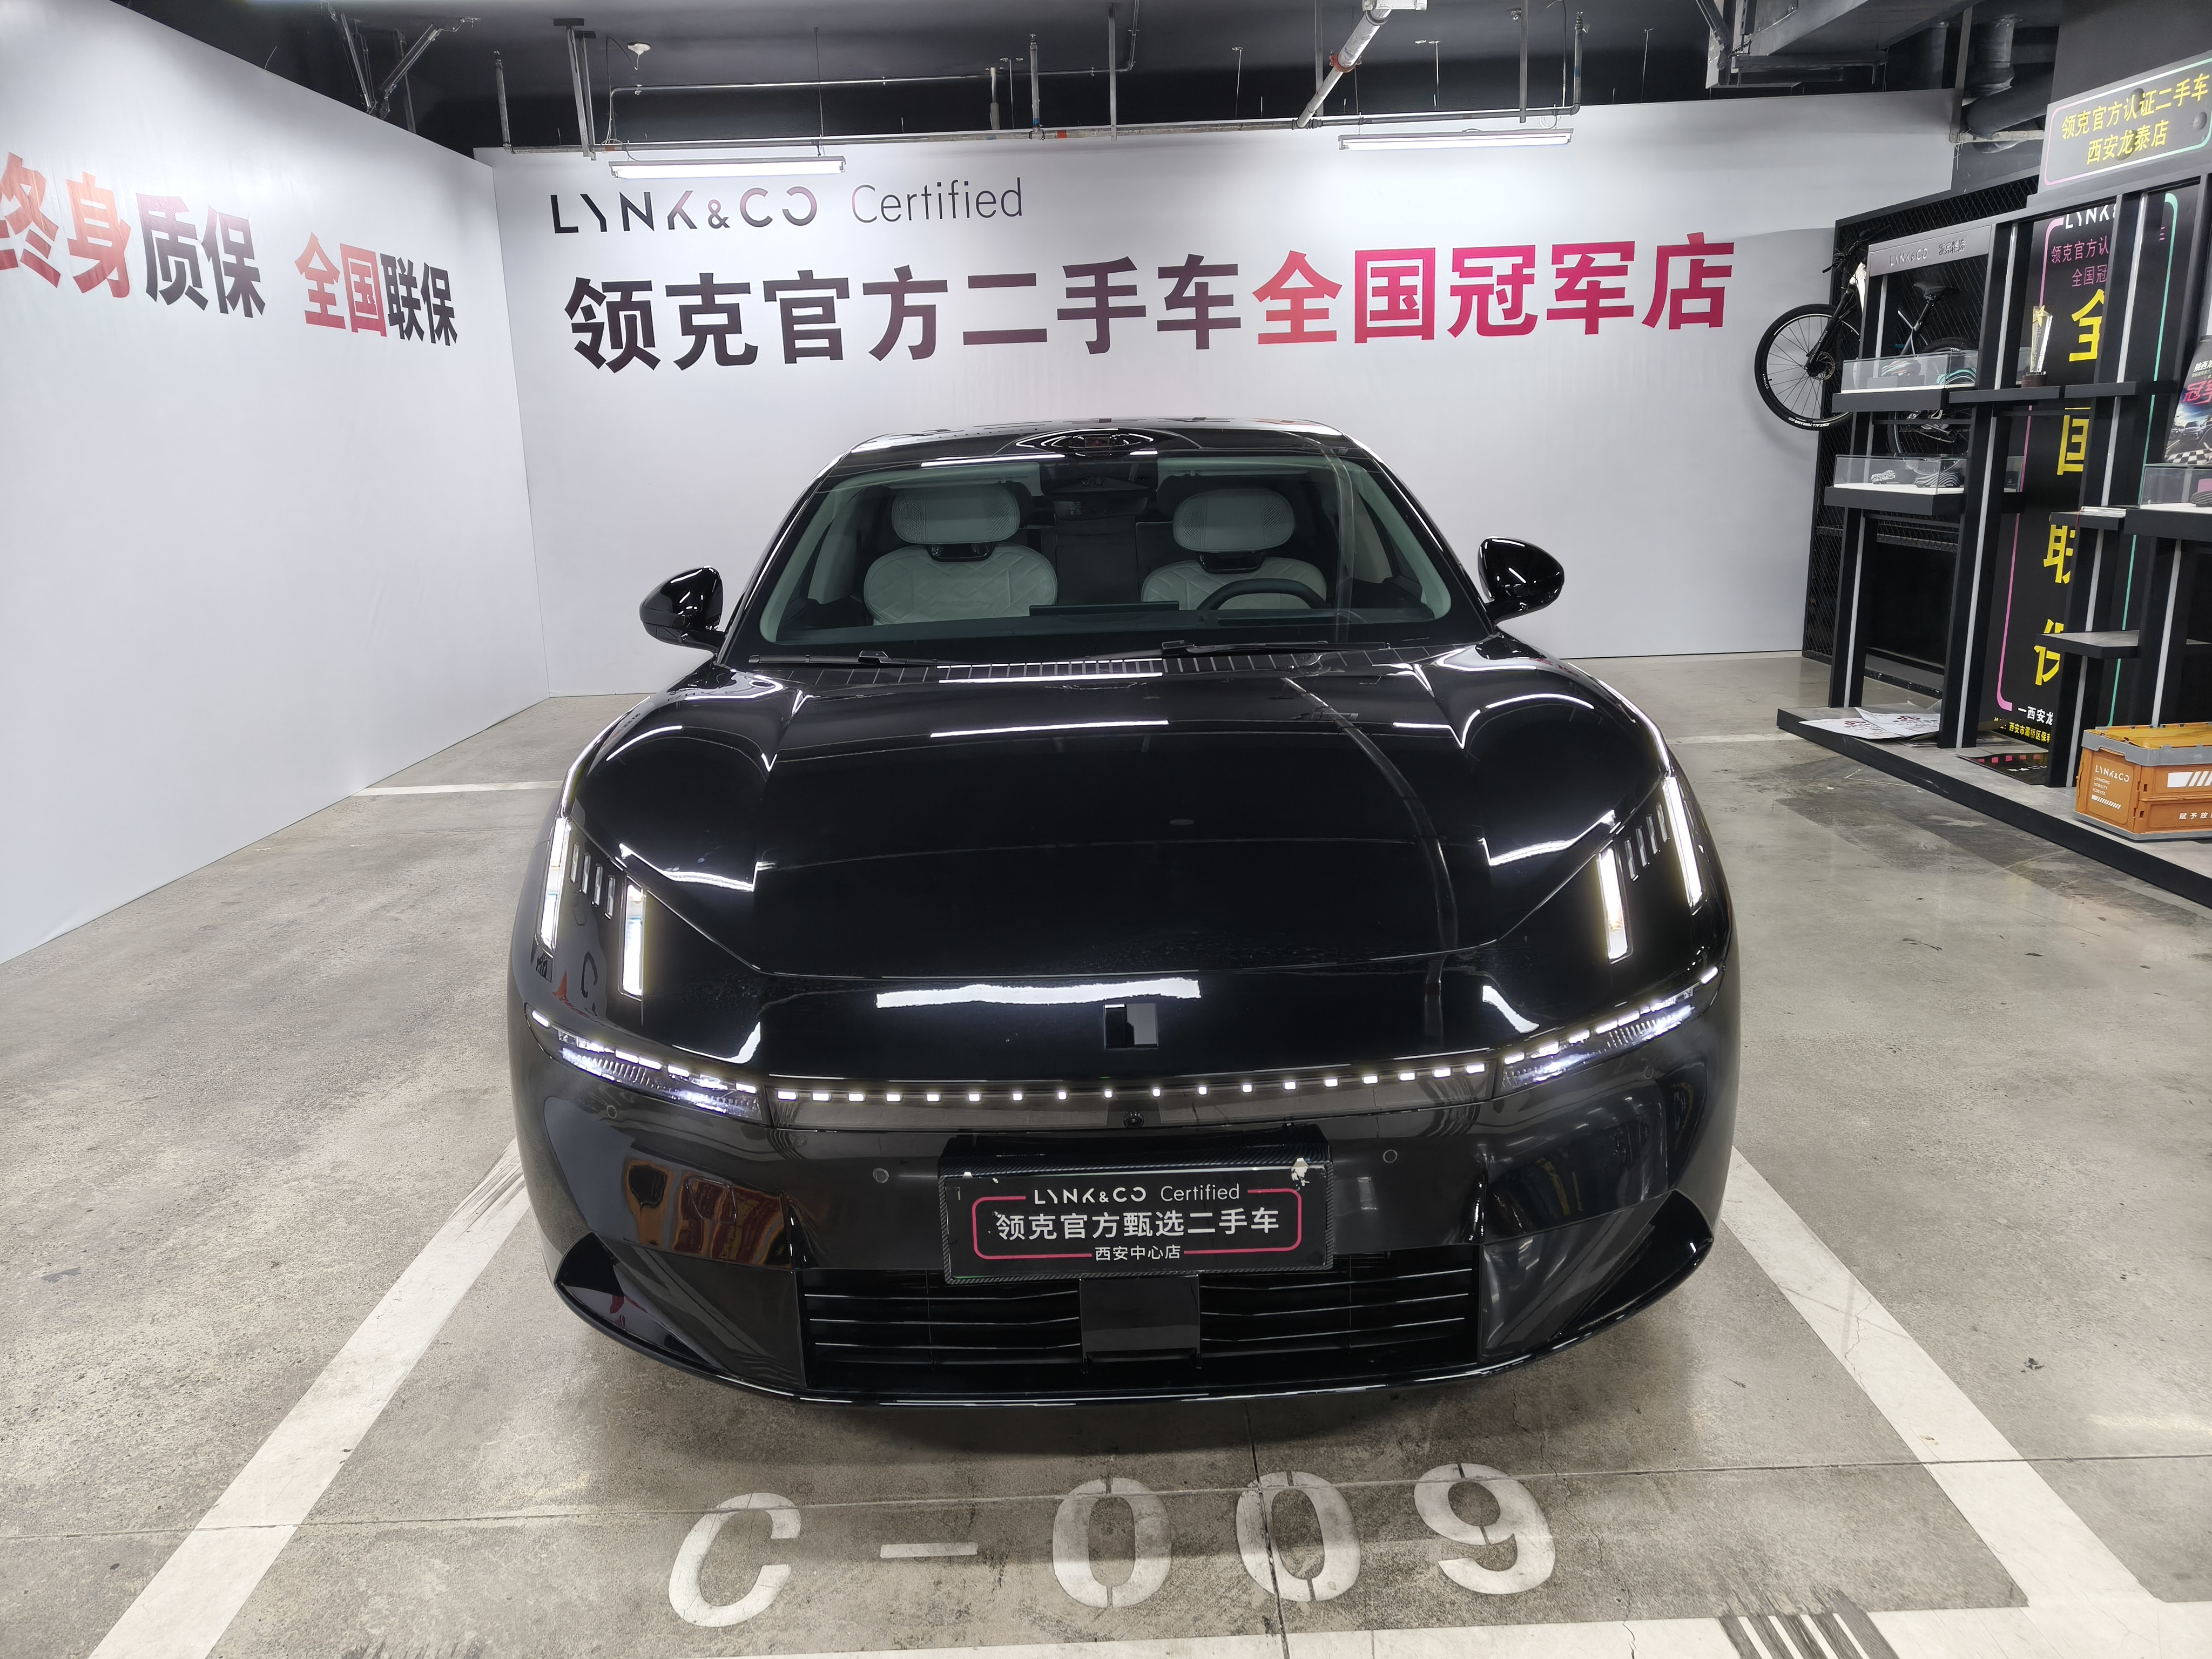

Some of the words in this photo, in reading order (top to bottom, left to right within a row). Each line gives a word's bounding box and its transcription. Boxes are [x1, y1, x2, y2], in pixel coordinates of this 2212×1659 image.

[2061, 73, 2210, 139] 领克官方认证二手车
[2086, 119, 2169, 165] 西安龙泰店
[550, 186, 818, 234] LYNK&CO
[851, 177, 1023, 222] Certified
[0, 152, 266, 318] 终身质保
[294, 232, 458, 346] 全国联保
[564, 232, 1735, 373] 领克官方二手车全国冠军店
[2095, 765, 2130, 782] LYNK&CO
[2179, 812, 2212, 820] 赋予放
[1034, 1186, 1147, 1204] LYNK&CO
[1160, 1184, 1240, 1202] Certified
[995, 1206, 1280, 1241] 领克官方甄选二手车
[1095, 1244, 1182, 1262] 西安中心店
